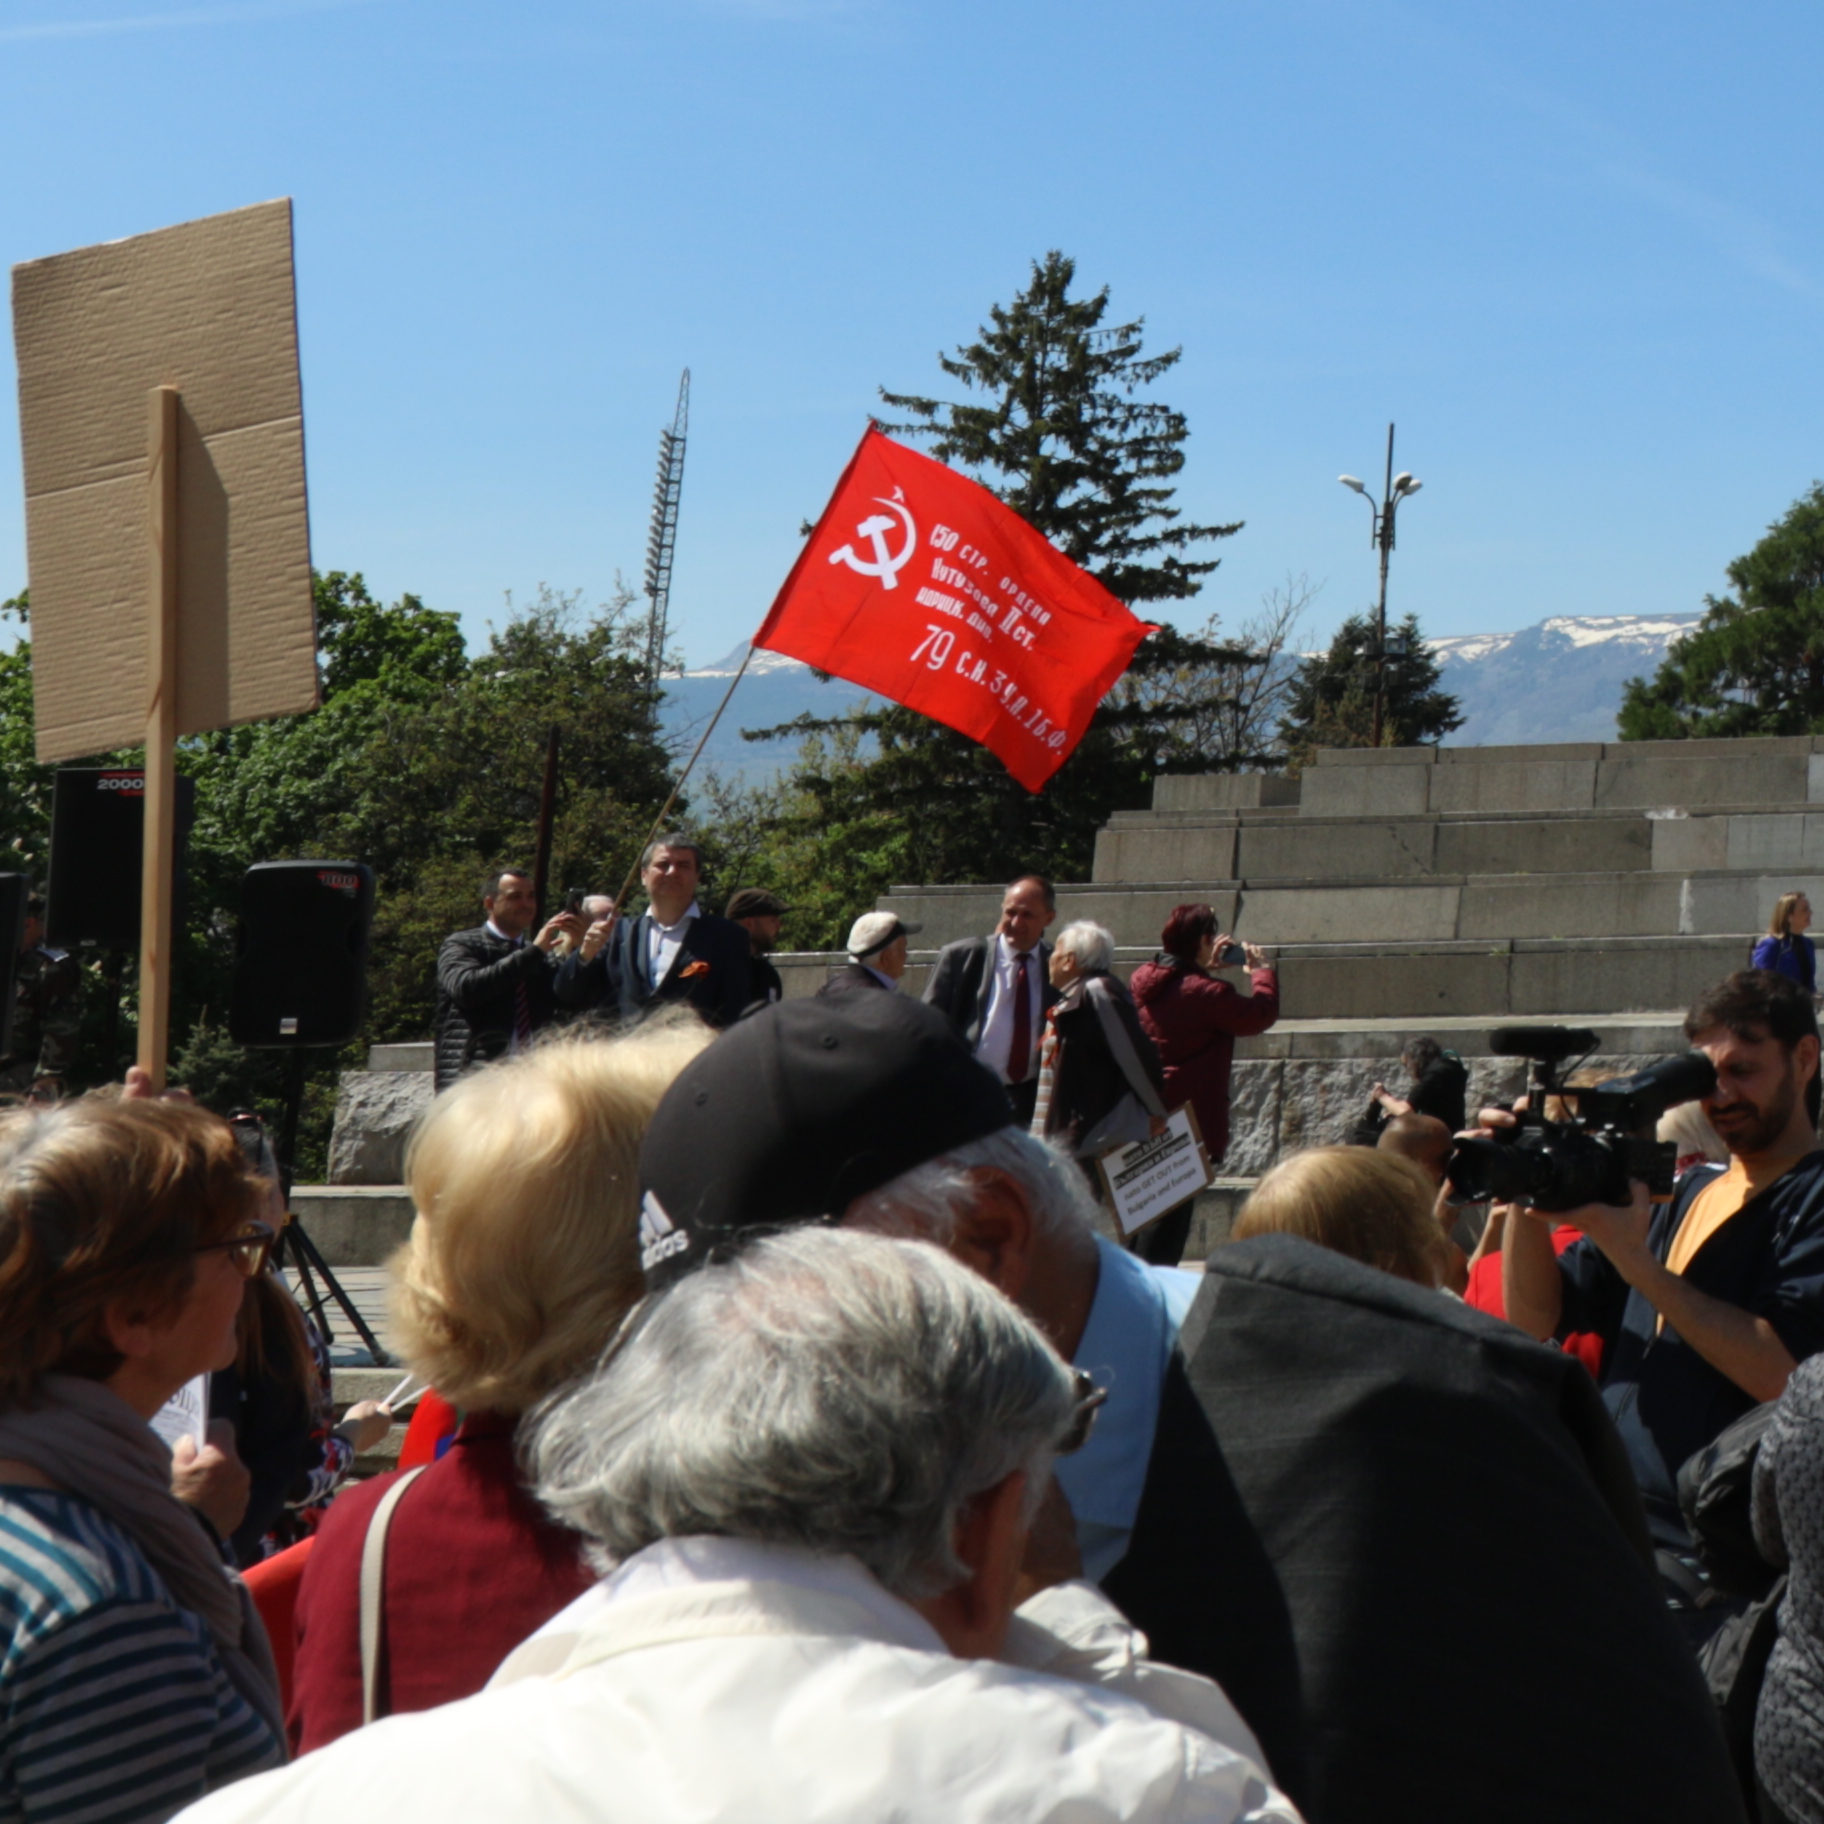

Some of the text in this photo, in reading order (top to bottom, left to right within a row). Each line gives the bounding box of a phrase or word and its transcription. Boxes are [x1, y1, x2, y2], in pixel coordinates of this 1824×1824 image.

[930, 524, 960, 552] 150
[910, 624, 955, 670] 79
[97, 778, 144, 790] 2000
